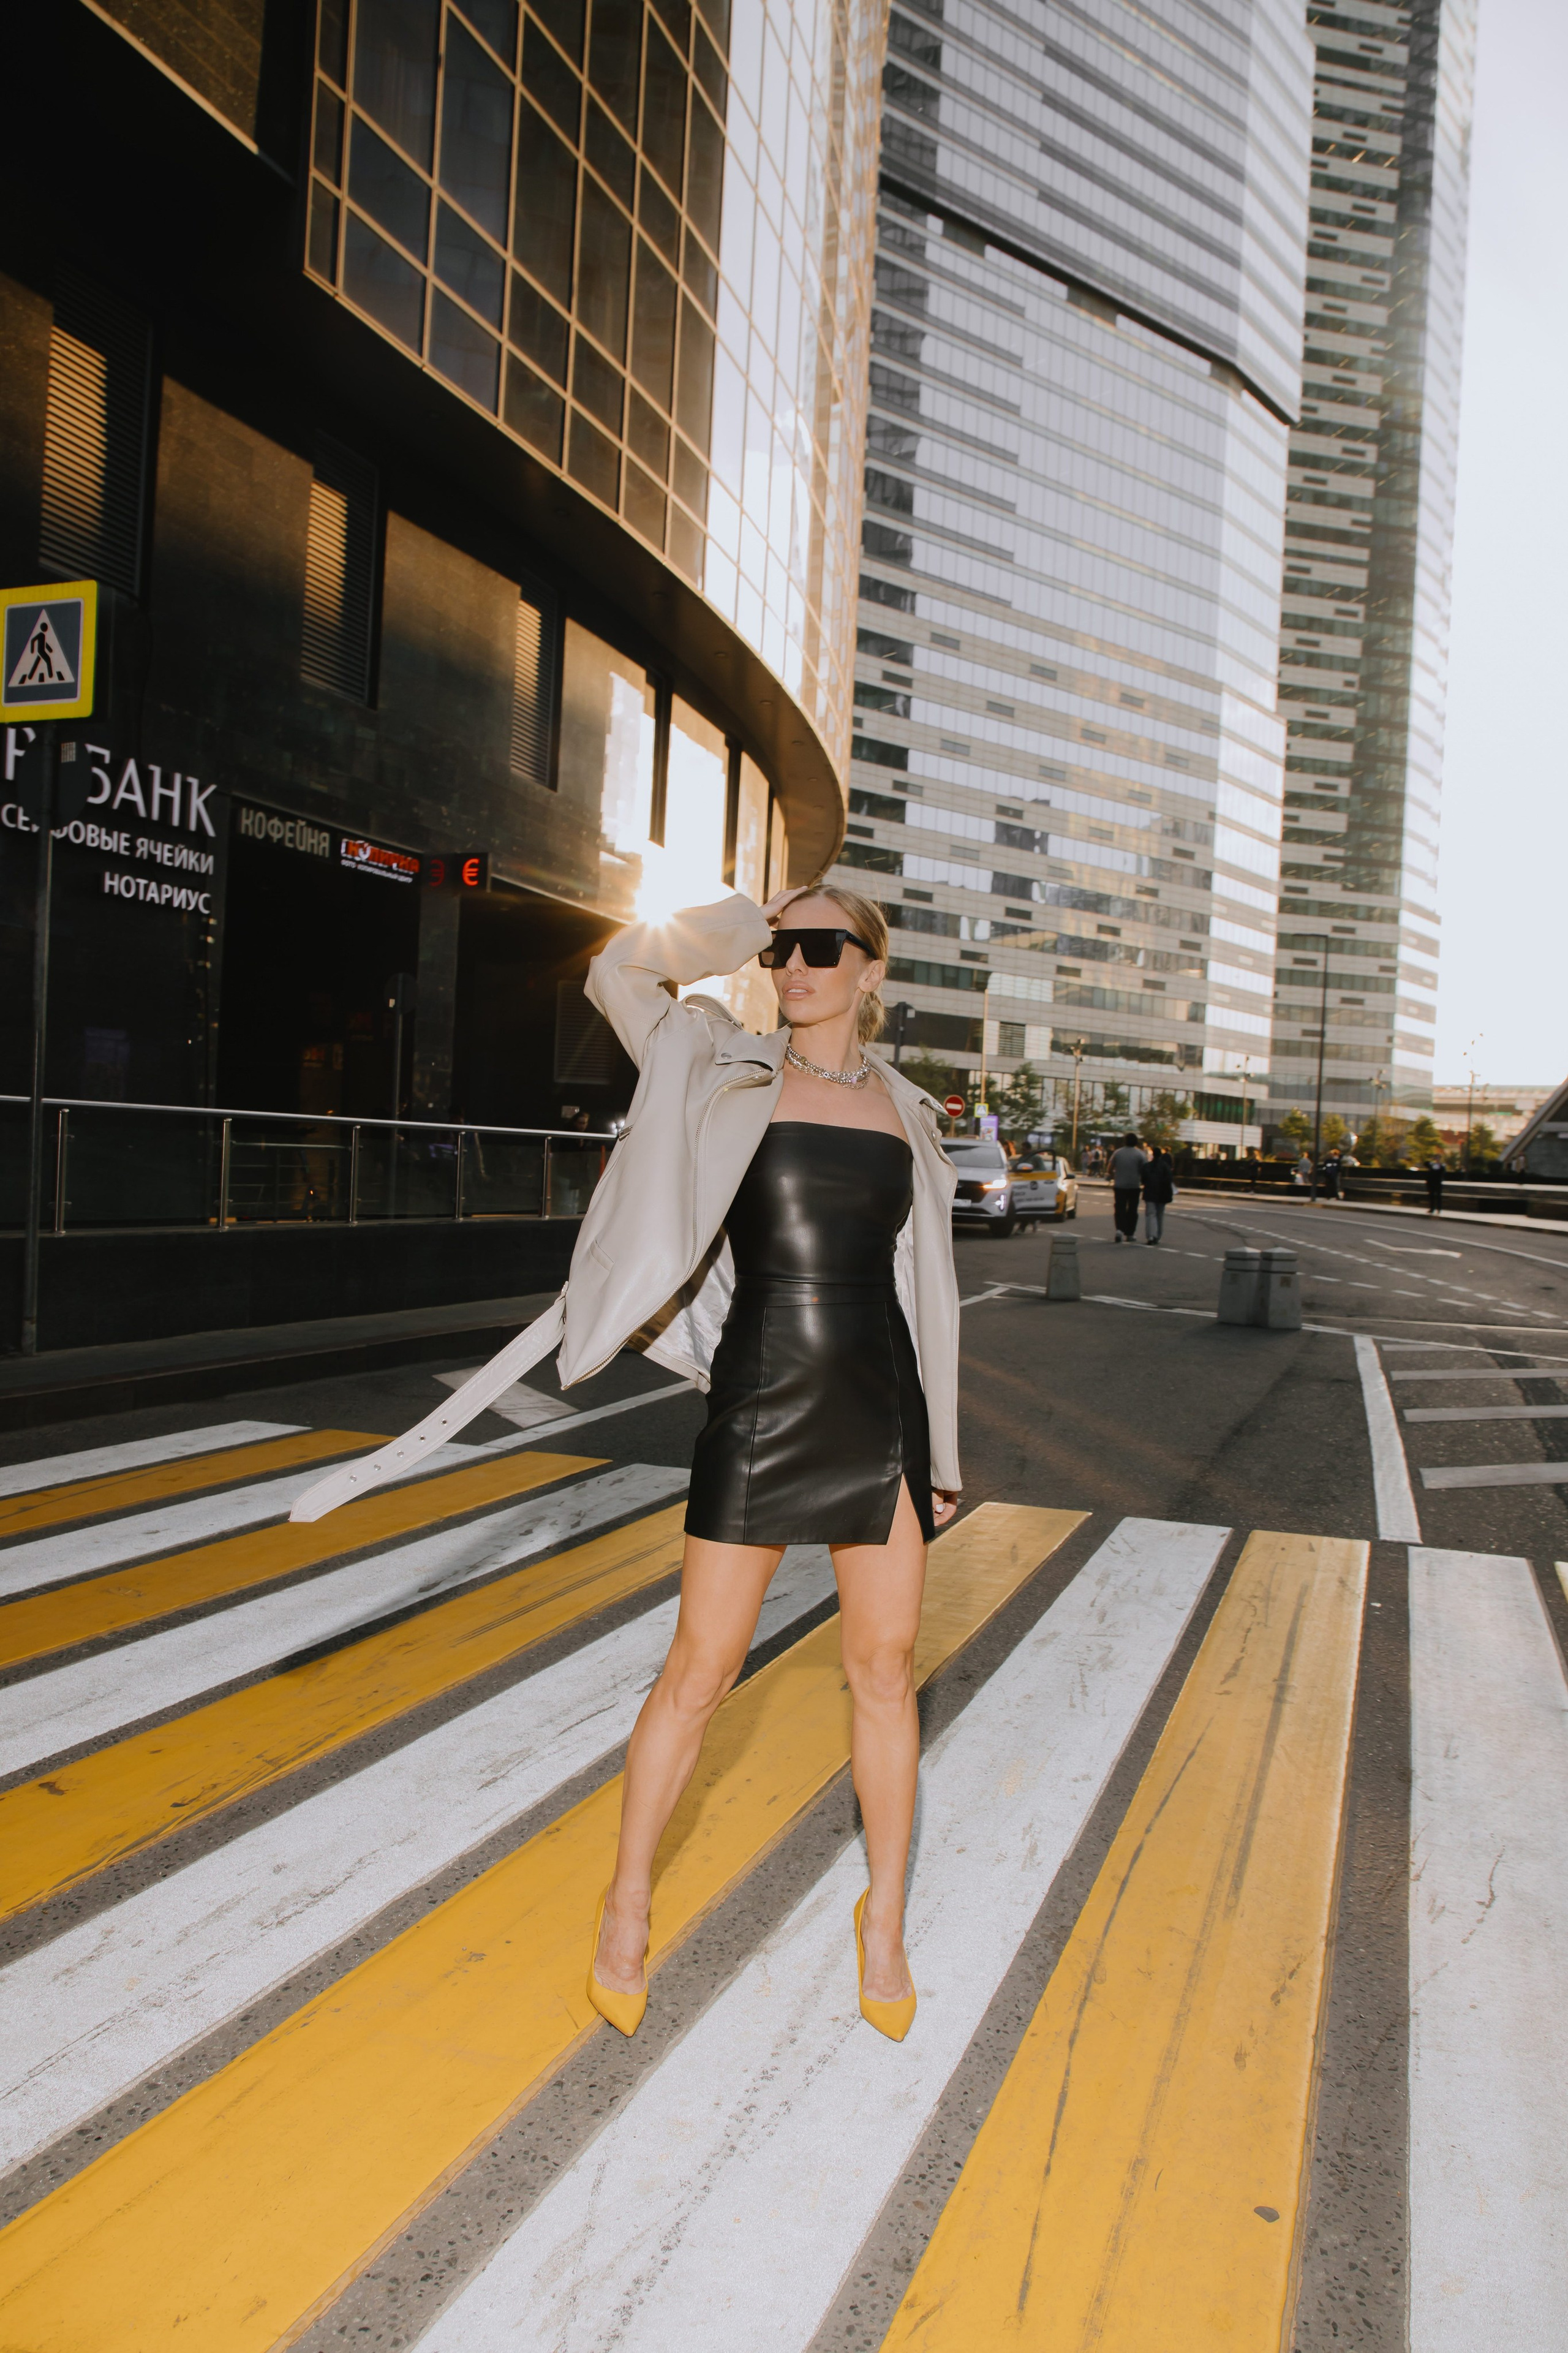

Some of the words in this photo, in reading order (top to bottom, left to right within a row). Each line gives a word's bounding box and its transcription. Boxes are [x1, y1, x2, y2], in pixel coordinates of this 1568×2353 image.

[241, 807, 331, 858] КОФЕЙНЯ
[135, 837, 214, 875] ЯЧЕЙКИ
[462, 858, 480, 886] €
[104, 871, 212, 915] НОТАРИУС
